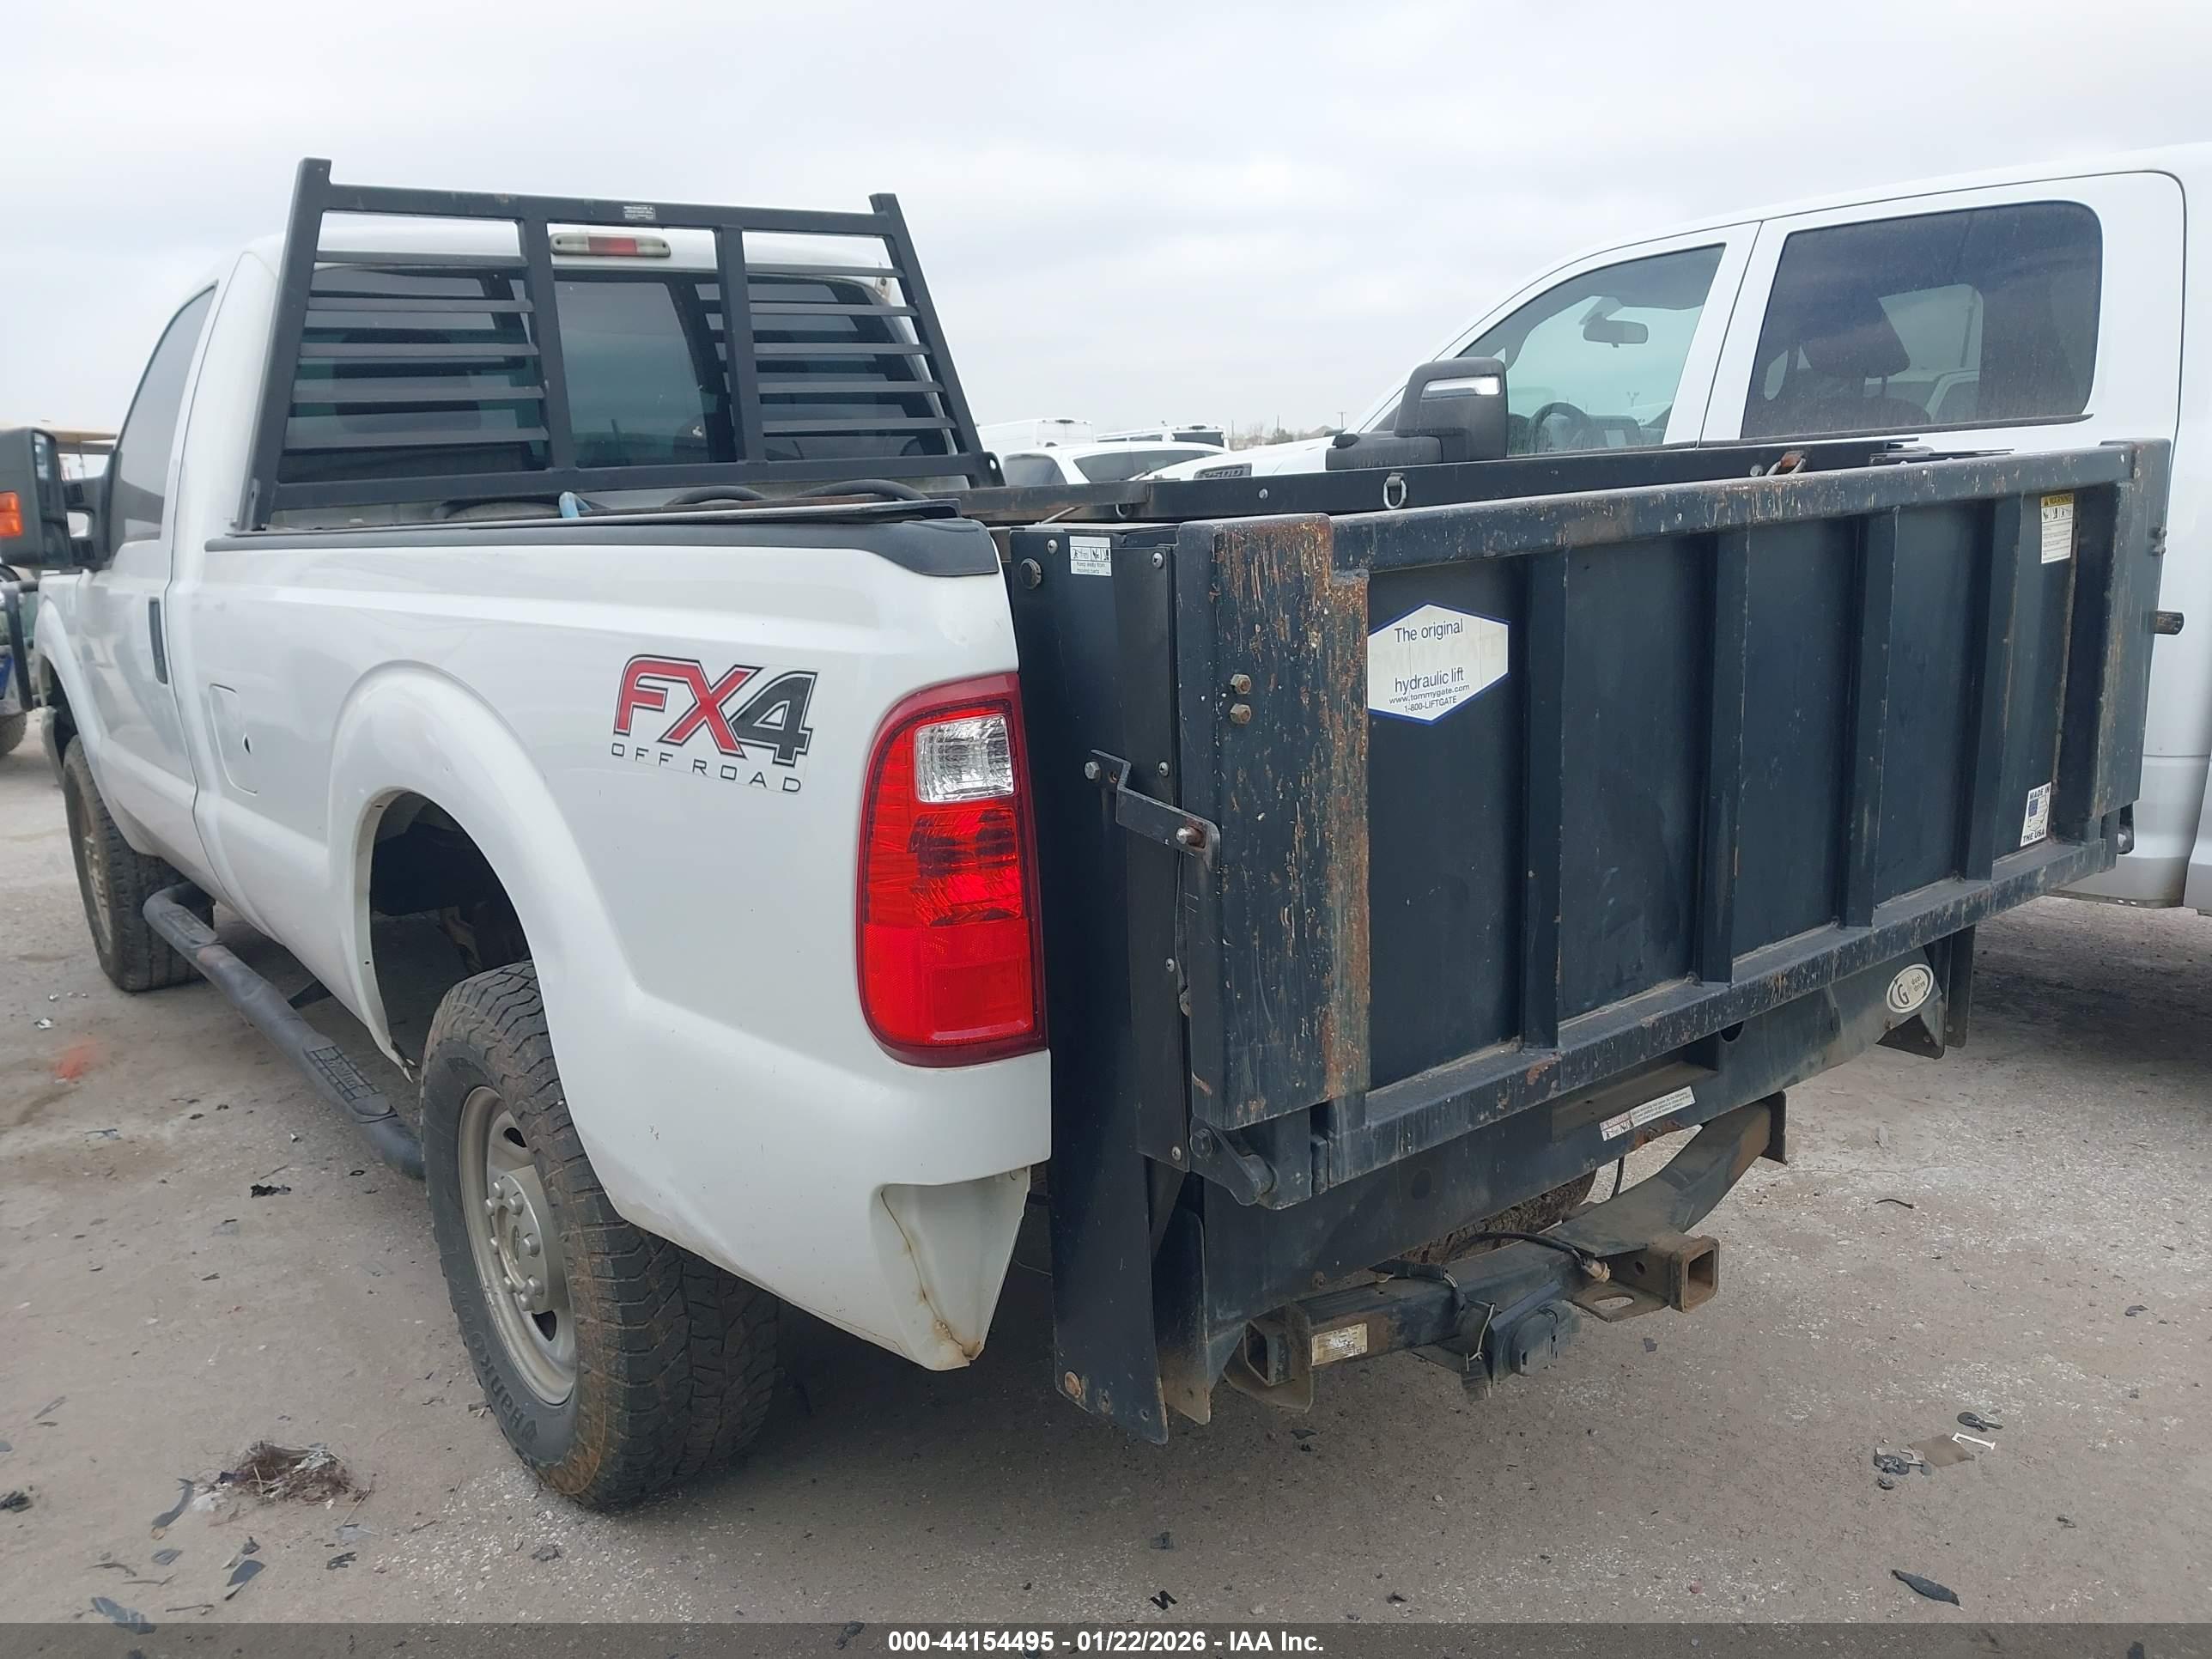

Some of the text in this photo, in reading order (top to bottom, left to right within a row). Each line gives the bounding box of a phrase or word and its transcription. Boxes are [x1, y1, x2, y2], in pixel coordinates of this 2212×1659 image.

[1204, 467, 1244, 478] 2500
[2048, 494, 2073, 506] WARNING
[1395, 618, 1463, 643] The original
[1395, 667, 1464, 695] hydraulic lift
[1389, 684, 1470, 704] www.tommygate.com
[613, 653, 818, 769] FX4
[1404, 696, 1457, 713] 1-800-LIFTGATE
[2029, 788, 2044, 799] MADE
[2023, 829, 2045, 842] THE USA
